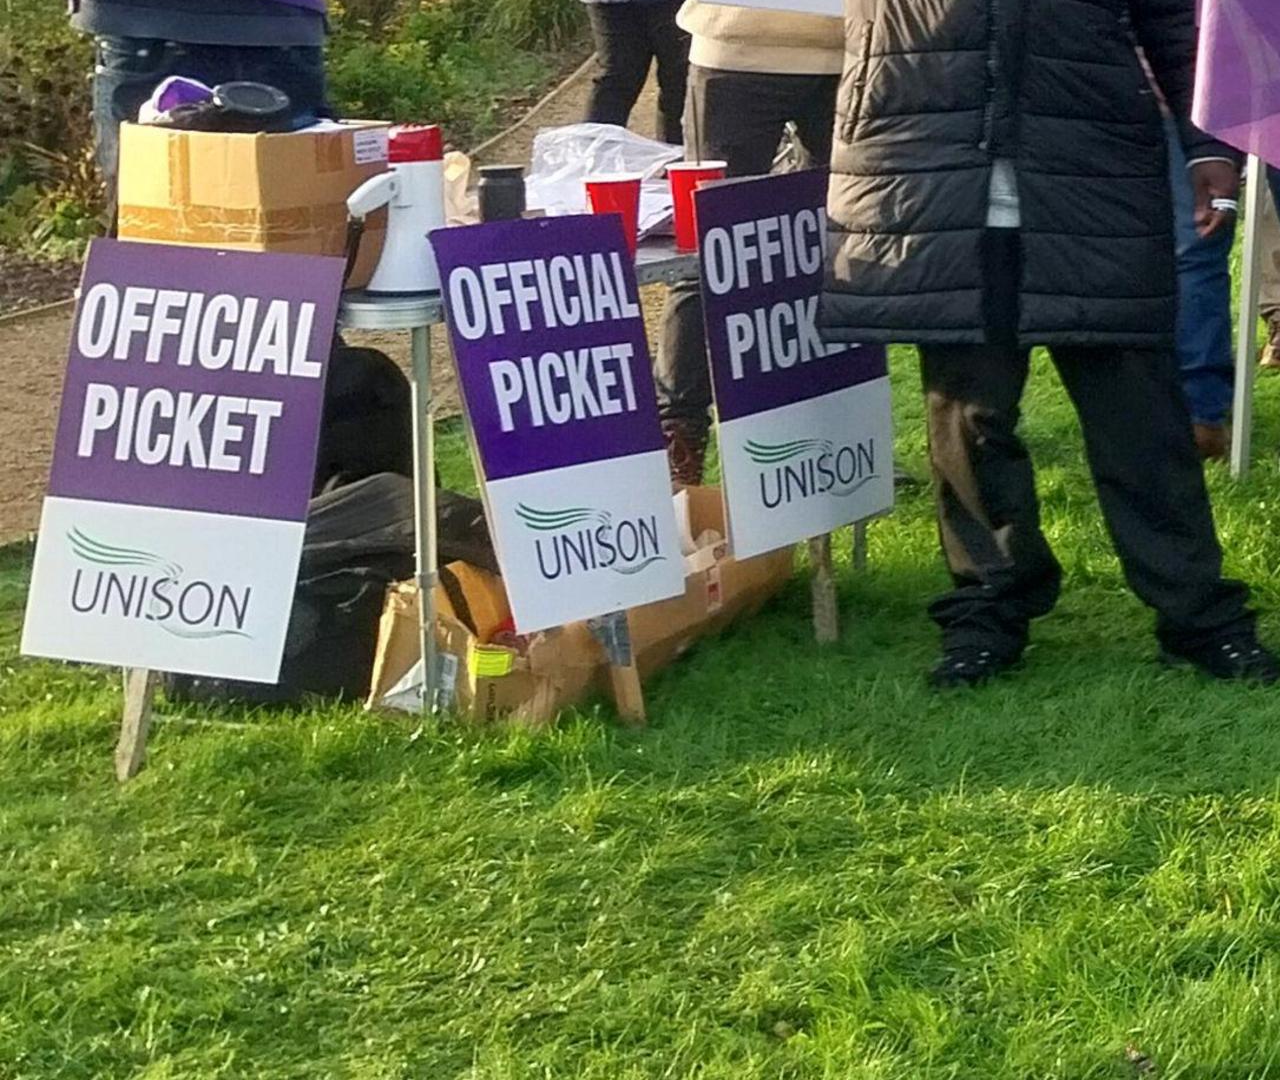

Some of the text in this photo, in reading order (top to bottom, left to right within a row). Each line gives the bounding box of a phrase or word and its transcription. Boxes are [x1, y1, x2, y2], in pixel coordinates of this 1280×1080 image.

[77, 282, 323, 378] OFFICIAL
[449, 251, 640, 340] OFFICIAL
[78, 382, 284, 475] PICKET
[489, 342, 638, 433] PICKET
[760, 438, 875, 509] UNISON
[536, 515, 660, 580] UNISON
[71, 568, 251, 630] UNISON
